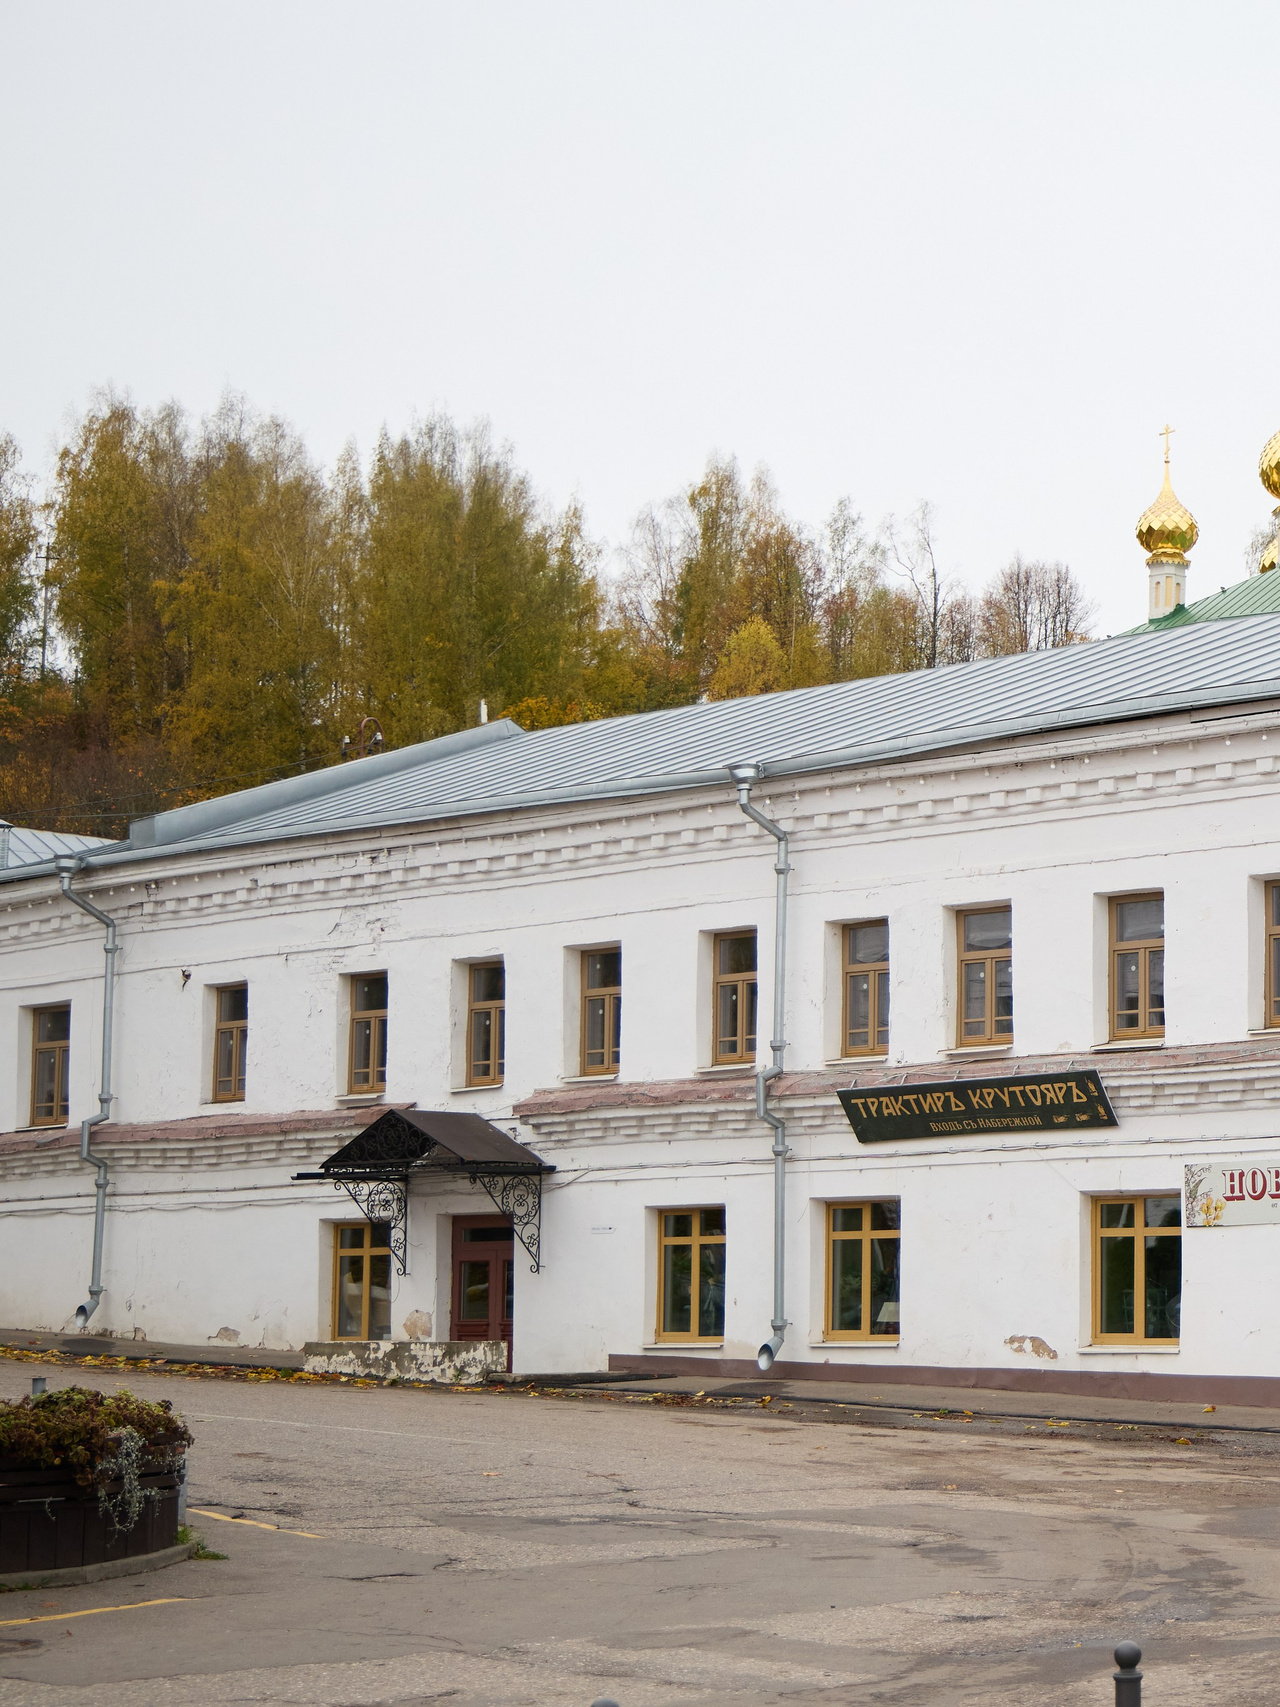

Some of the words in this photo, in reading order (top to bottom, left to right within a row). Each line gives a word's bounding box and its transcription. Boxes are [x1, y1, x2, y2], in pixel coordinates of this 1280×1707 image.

[850, 1090, 966, 1119] ТРАКТИРЪ
[967, 1081, 1088, 1110] КРУТОЯРЪ
[929, 1120, 963, 1132] ВХОДЪ
[977, 1114, 1043, 1128] НАБЕРЕЖНОЙ
